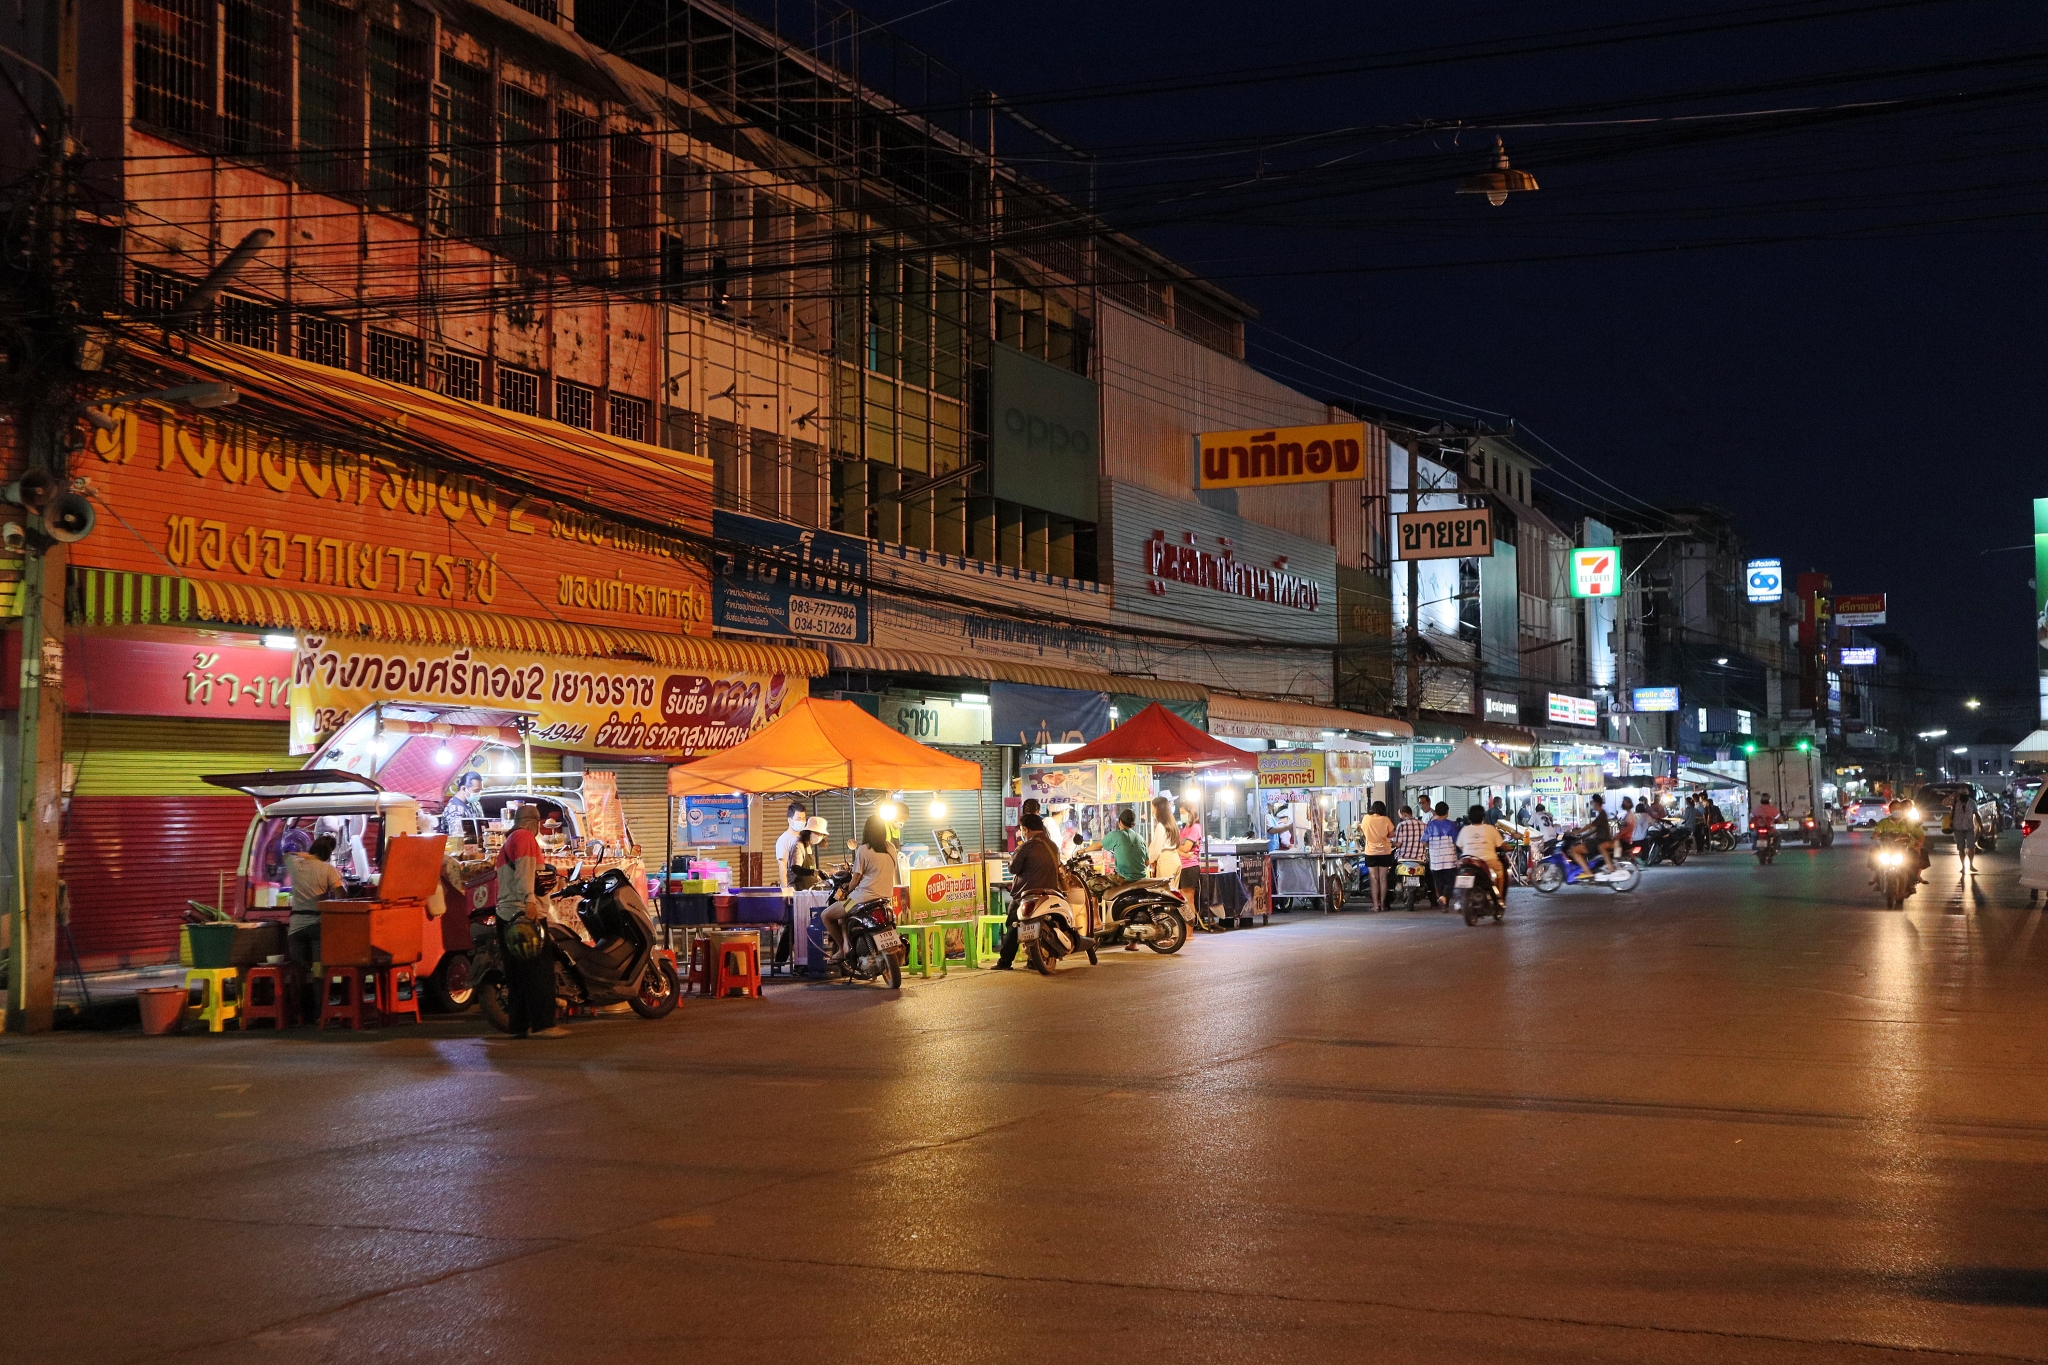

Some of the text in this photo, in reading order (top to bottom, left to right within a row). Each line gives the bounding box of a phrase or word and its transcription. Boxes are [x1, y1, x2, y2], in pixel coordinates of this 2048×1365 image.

[1204, 431, 1360, 481] นาทีทอง
[1402, 518, 1488, 551] ขายยา
[165, 514, 498, 605] ทองจากเยาวราช
[1580, 555, 1609, 595] 7
[557, 568, 705, 635] ทองเก่าราคาสูง
[791, 599, 855, 620] 083-7777986
[794, 617, 852, 636] 034-512624
[294, 636, 655, 706] ห้างทองศรีทอง2 เยาวราช
[665, 679, 708, 714] รับซื้อ
[597, 714, 750, 757] จำนำ ราคาสูงพิเศษ
[897, 707, 939, 737] ราชา
[1260, 754, 1311, 769] สลัดผัก
